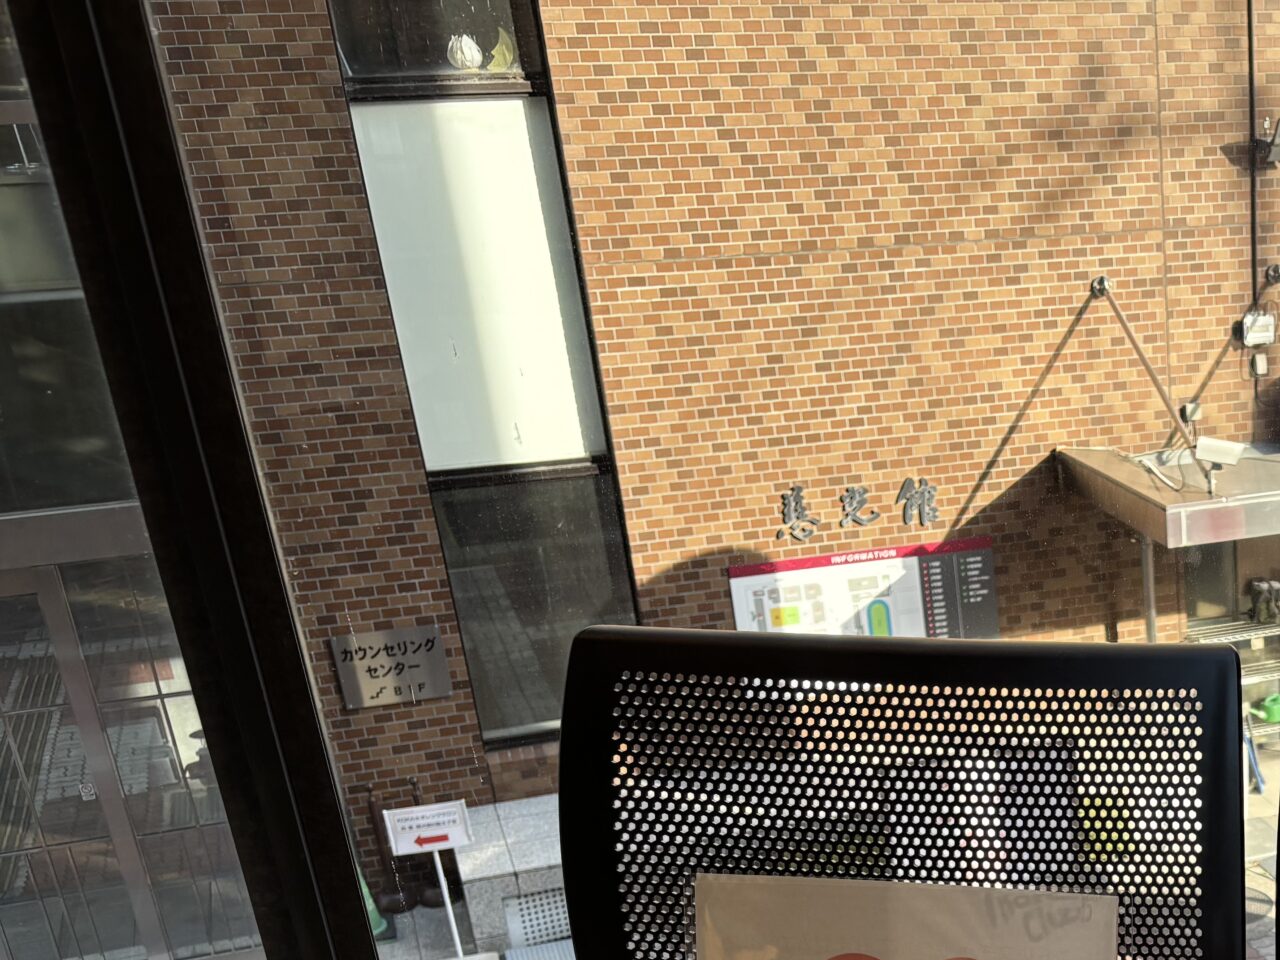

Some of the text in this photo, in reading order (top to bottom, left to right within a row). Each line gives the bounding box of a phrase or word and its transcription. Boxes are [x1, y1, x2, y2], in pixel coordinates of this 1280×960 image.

[830, 548, 897, 565] INFORMATION
[341, 636, 437, 662] カウンセリング
[365, 662, 421, 679] センター
